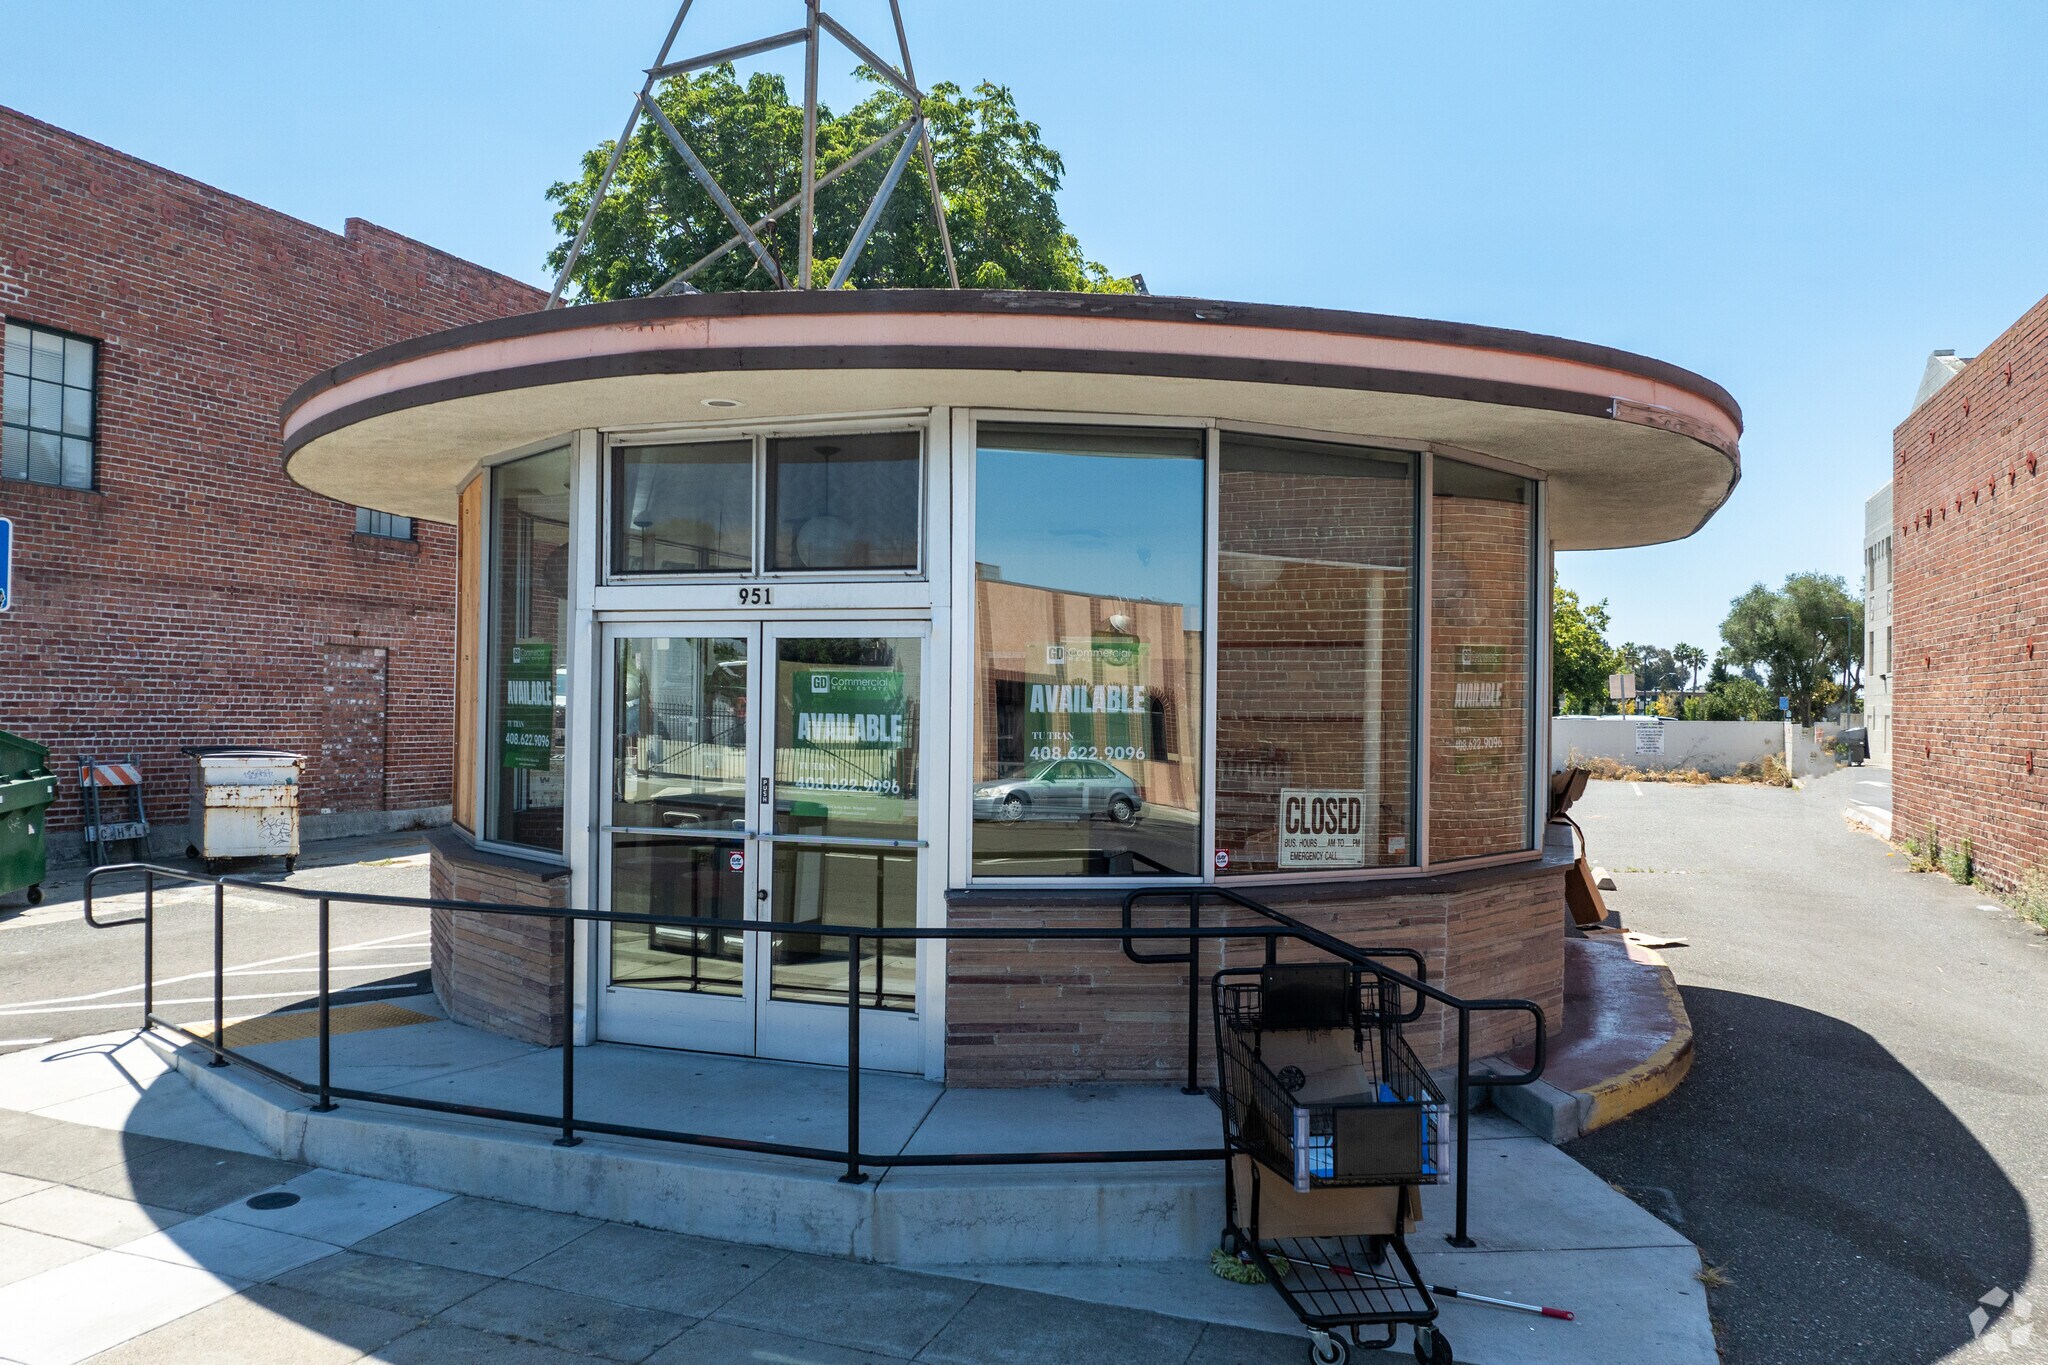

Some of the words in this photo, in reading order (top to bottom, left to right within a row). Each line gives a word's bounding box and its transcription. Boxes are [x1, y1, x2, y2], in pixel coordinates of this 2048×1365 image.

[739, 587, 771, 605] 951
[813, 676, 828, 689] GD
[831, 677, 888, 687] Commercial
[507, 680, 552, 706] AVAILABLE
[1030, 684, 1145, 713] AVAILABLE
[1454, 682, 1502, 708] AVAILABLE
[797, 712, 902, 743] AVAILABLE
[1032, 731, 1046, 740] TU
[1047, 731, 1075, 741] TRAN
[505, 732, 550, 747] 408.622.9096
[1029, 746, 1146, 760] 408.622.9096
[795, 776, 901, 795] 408.622.9096
[1285, 796, 1361, 835] CLOSED
[1284, 838, 1297, 848] BUS.
[1299, 838, 1318, 848] HOURS
[1327, 838, 1336, 848] AM
[1337, 838, 1345, 847] TO
[1352, 838, 1361, 847] PM
[1290, 851, 1323, 861] EMERGENCY
[1324, 851, 1338, 860] CALL
